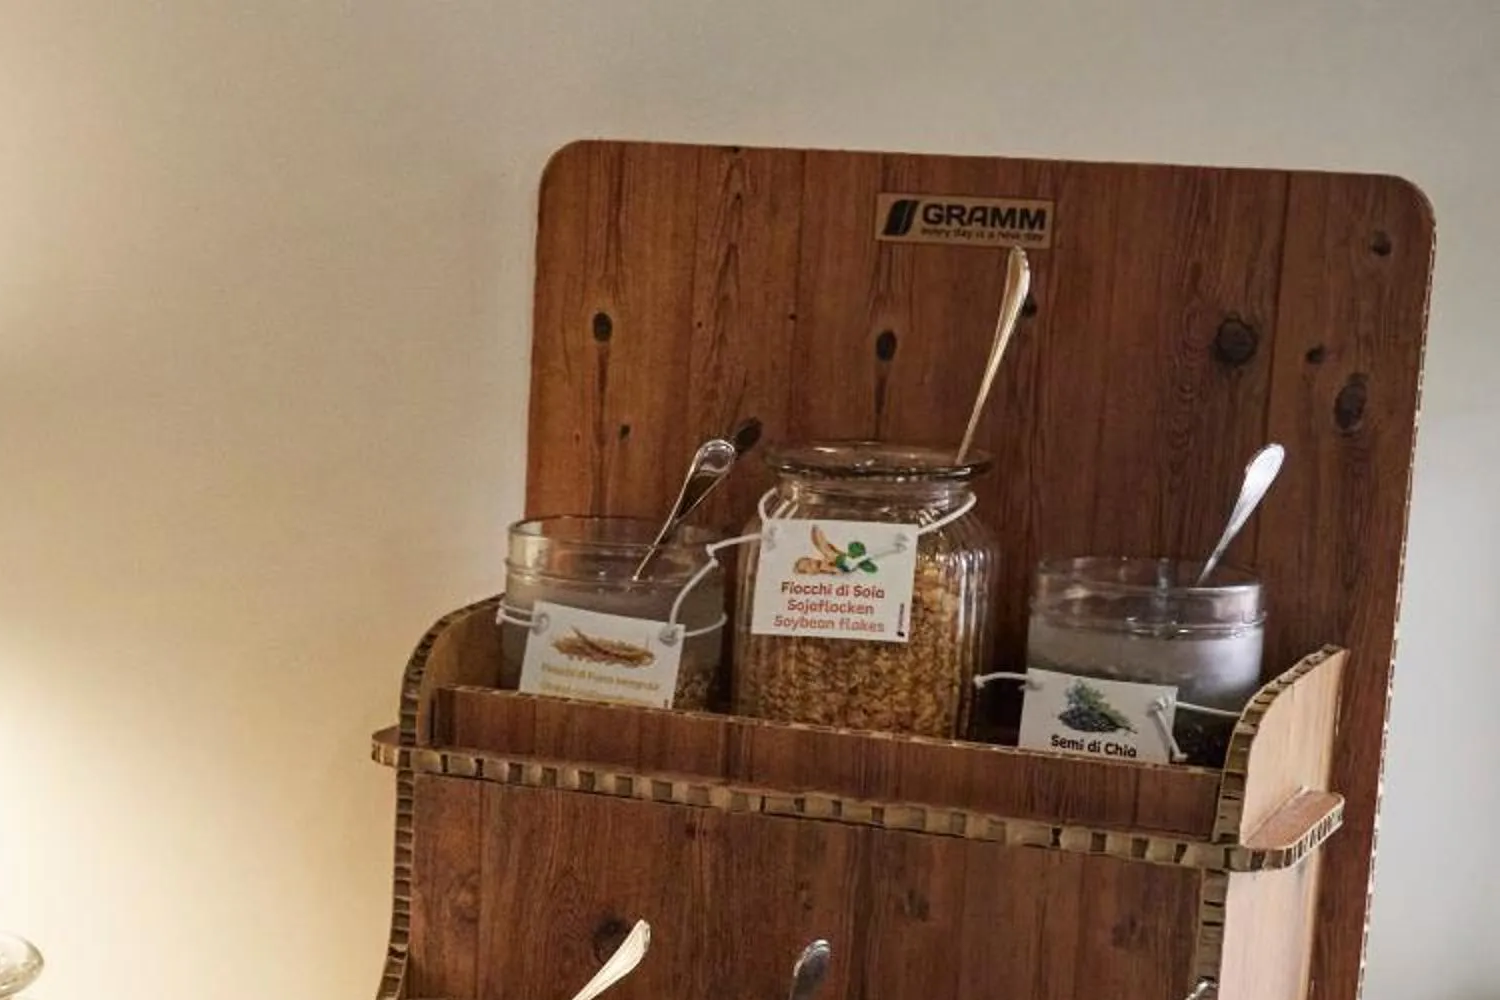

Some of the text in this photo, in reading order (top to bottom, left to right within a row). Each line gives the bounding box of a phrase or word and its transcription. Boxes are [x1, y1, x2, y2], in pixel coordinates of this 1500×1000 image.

[922, 203, 1047, 231] GRAMM
[781, 581, 885, 599] Fiocchi di Soia
[1051, 734, 1137, 758] Semi di Chia
